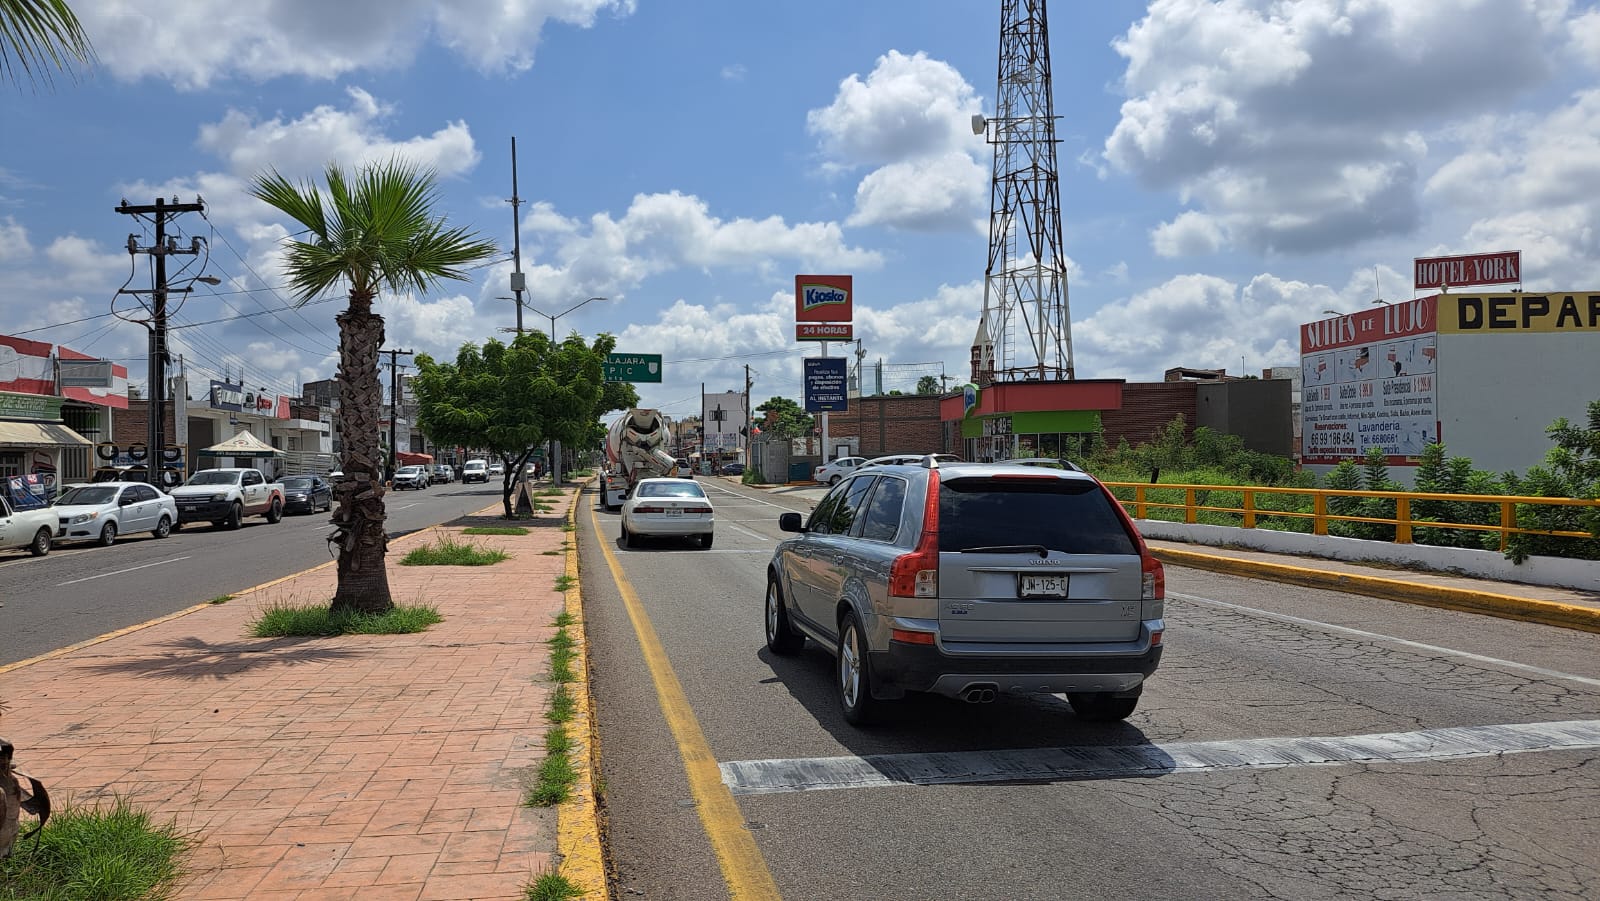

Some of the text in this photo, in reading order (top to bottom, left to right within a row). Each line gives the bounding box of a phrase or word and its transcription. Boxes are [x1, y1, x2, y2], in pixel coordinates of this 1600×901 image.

[1417, 256, 1517, 285] HOTEL YORK
[806, 289, 845, 306] Kiosko
[803, 326, 848, 335] 24 HORAS
[1307, 298, 1429, 349] SUITES DE LUJO
[602, 357, 646, 366] ALAJARA
